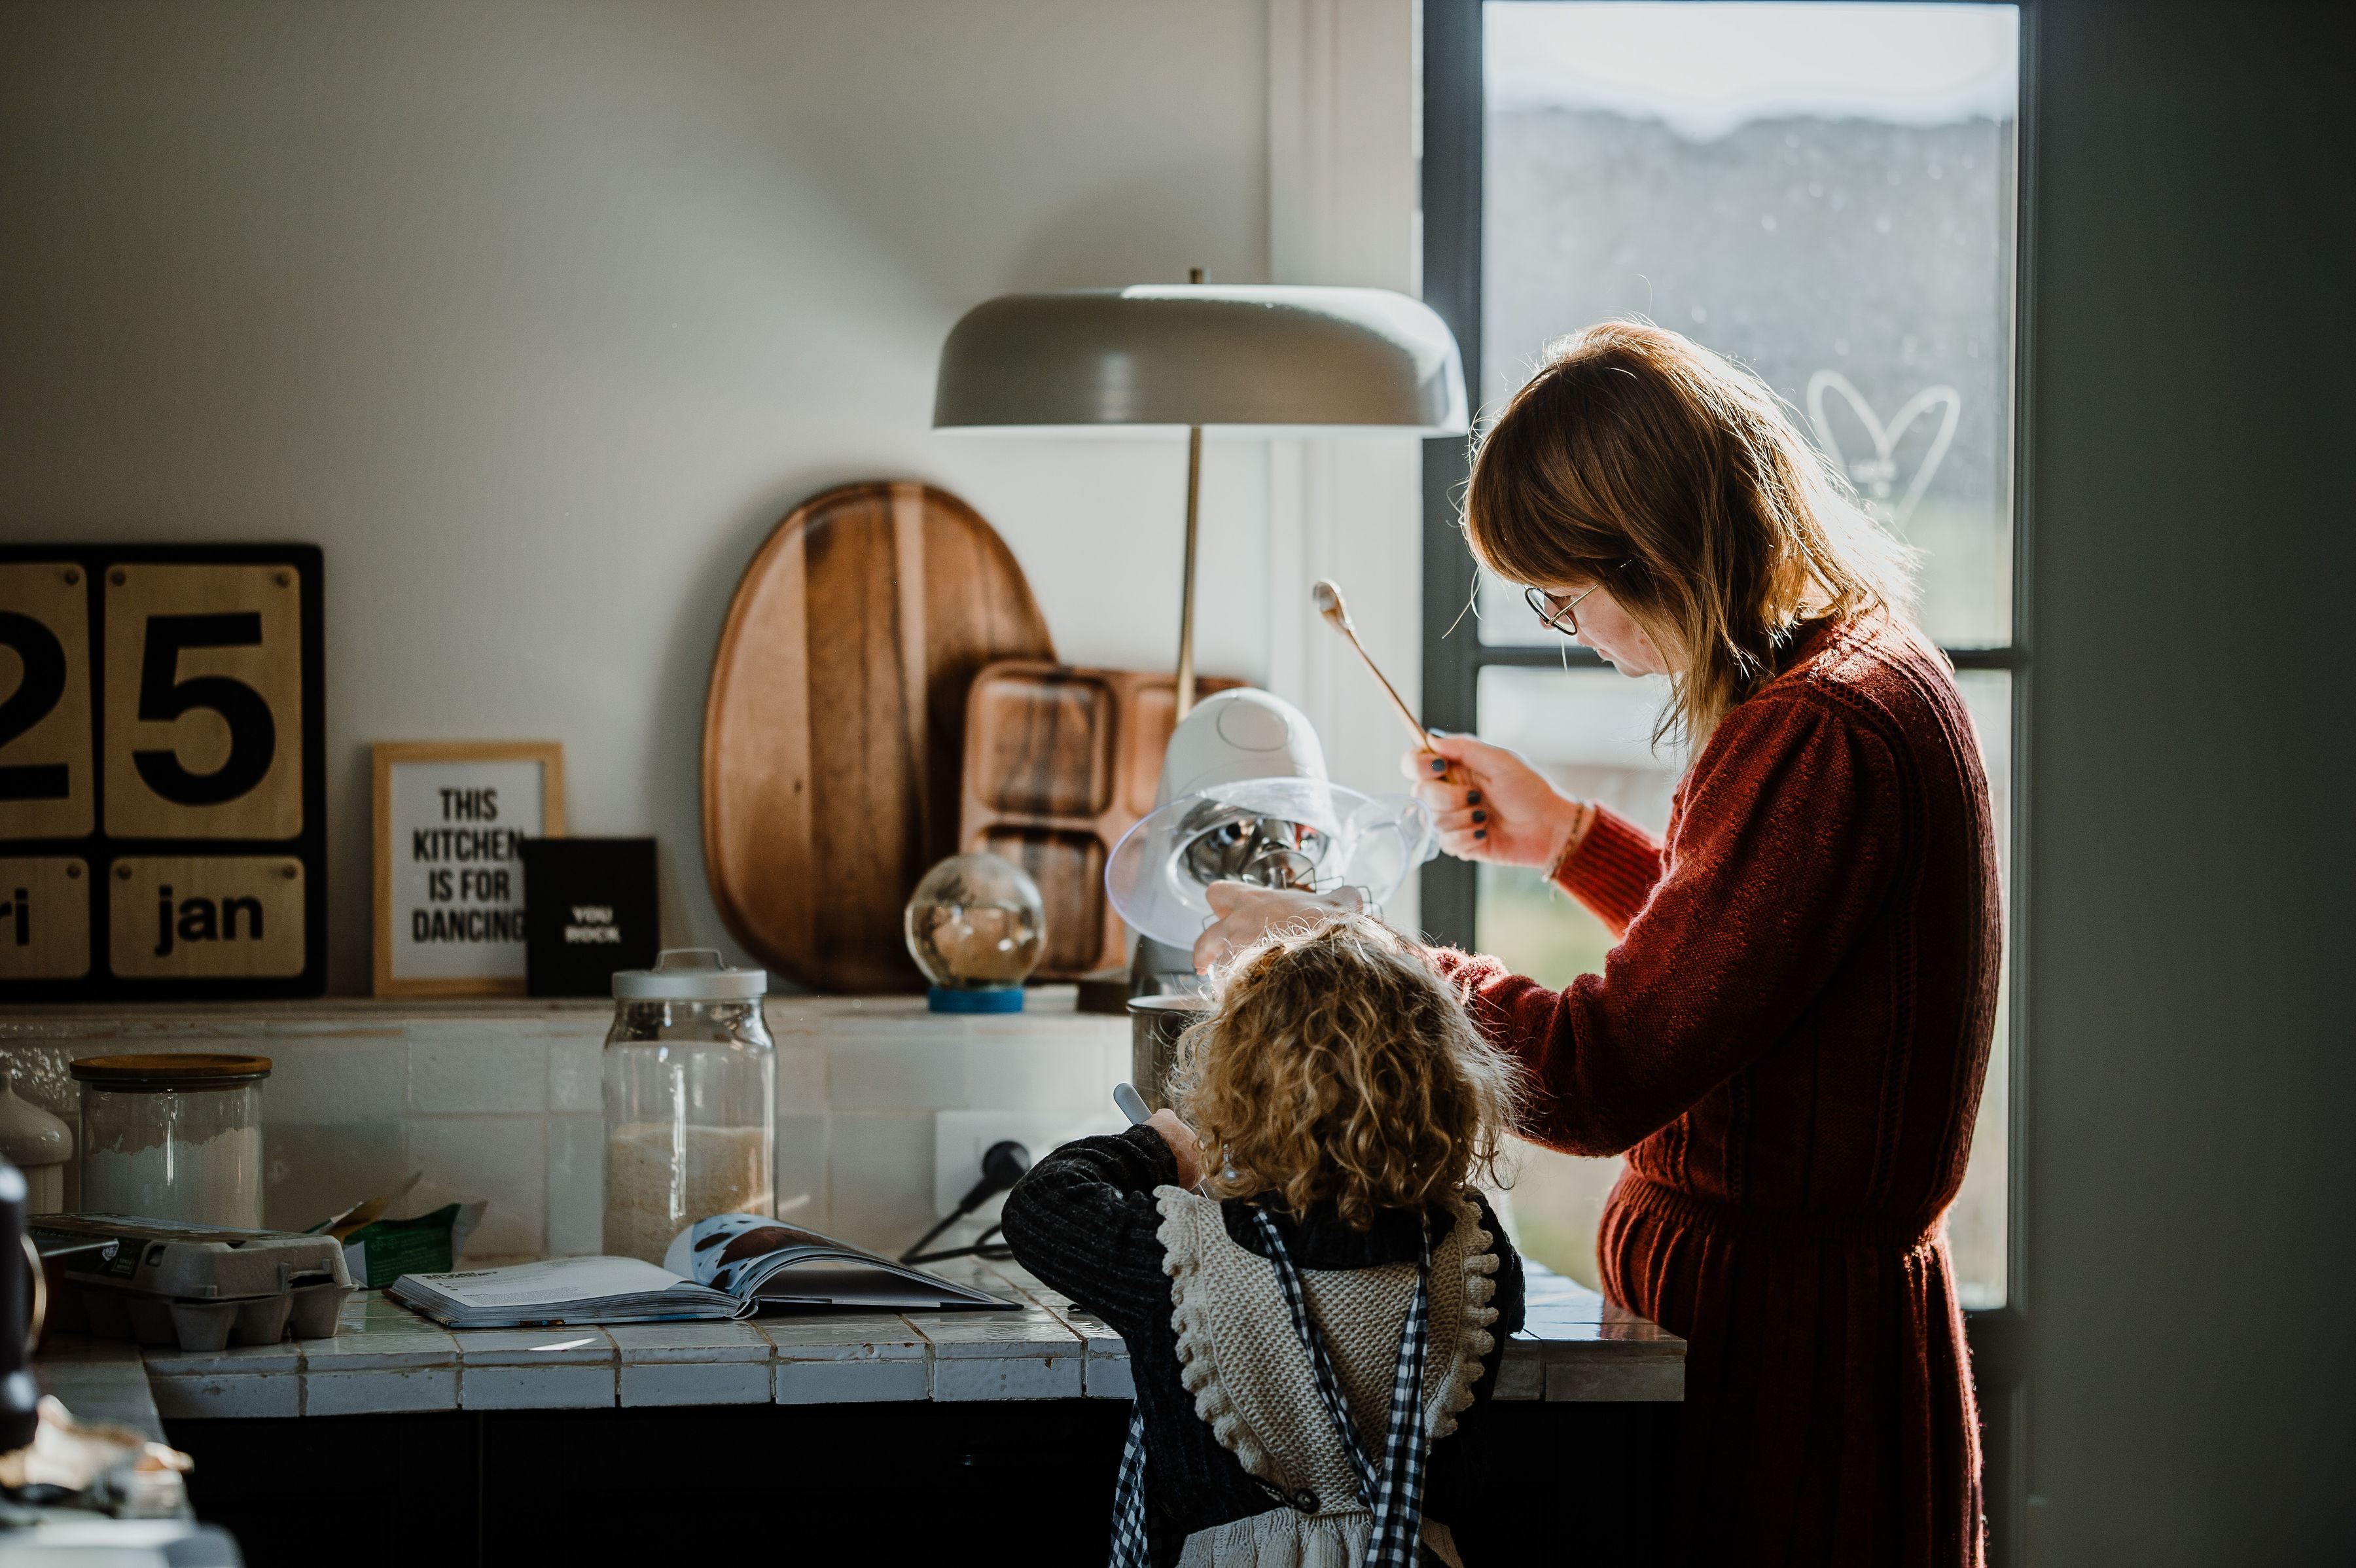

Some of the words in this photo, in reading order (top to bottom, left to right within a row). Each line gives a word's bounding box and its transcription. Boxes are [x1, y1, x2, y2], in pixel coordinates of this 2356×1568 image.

[439, 788, 498, 821] THIS
[413, 828, 524, 861] KITCHEN
[429, 868, 452, 902] IS
[461, 868, 510, 902] FOR
[154, 885, 264, 956] jan
[413, 909, 529, 943] DANCING
[571, 905, 614, 923] YOU
[564, 922, 622, 942] ROCK
